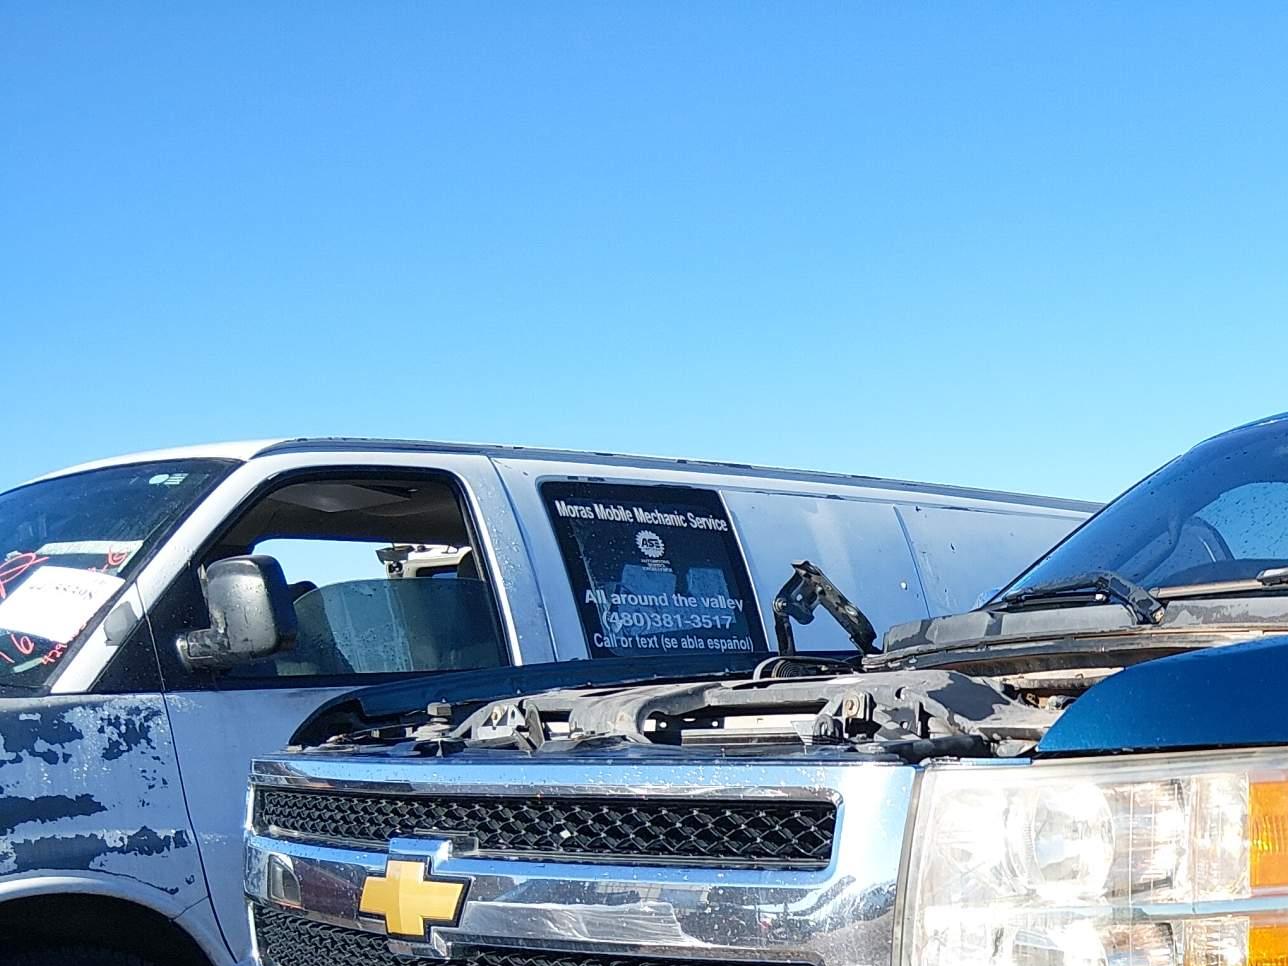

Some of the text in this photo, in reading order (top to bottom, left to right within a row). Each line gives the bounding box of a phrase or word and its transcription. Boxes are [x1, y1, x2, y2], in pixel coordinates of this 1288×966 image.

[555, 500, 728, 532] Moras Mobile Mechanic Service
[585, 589, 743, 612] All around the valley
[602, 610, 732, 630] (480)381-3517
[594, 633, 754, 652] Call or text (se abla español)
